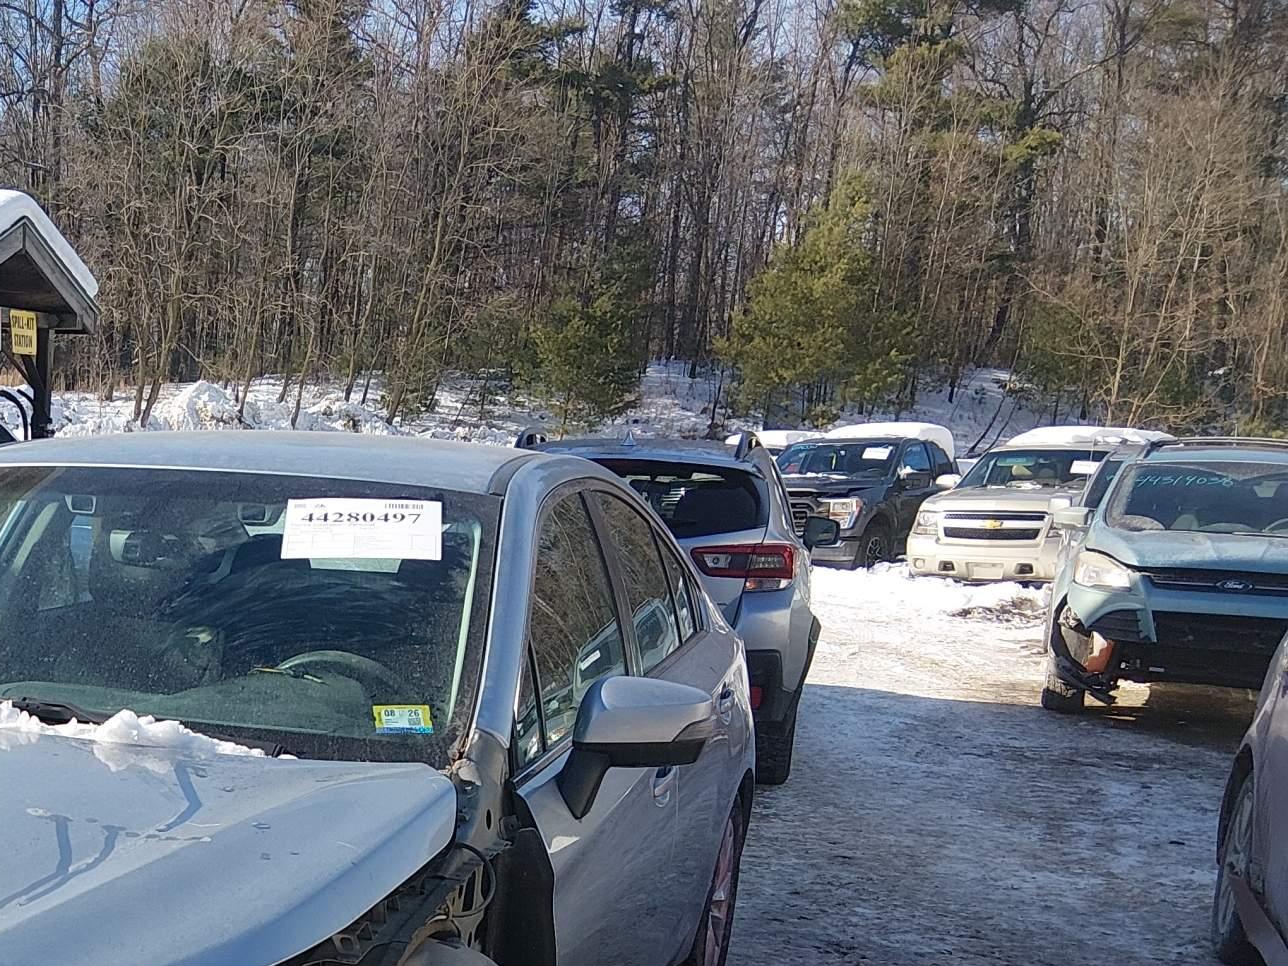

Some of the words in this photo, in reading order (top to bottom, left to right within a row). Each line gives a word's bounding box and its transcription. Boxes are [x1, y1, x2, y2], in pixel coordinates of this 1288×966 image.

[14, 333, 33, 348] STATION
[301, 511, 422, 524] 44280497
[384, 709, 396, 717] 08
[408, 709, 420, 717] 26
